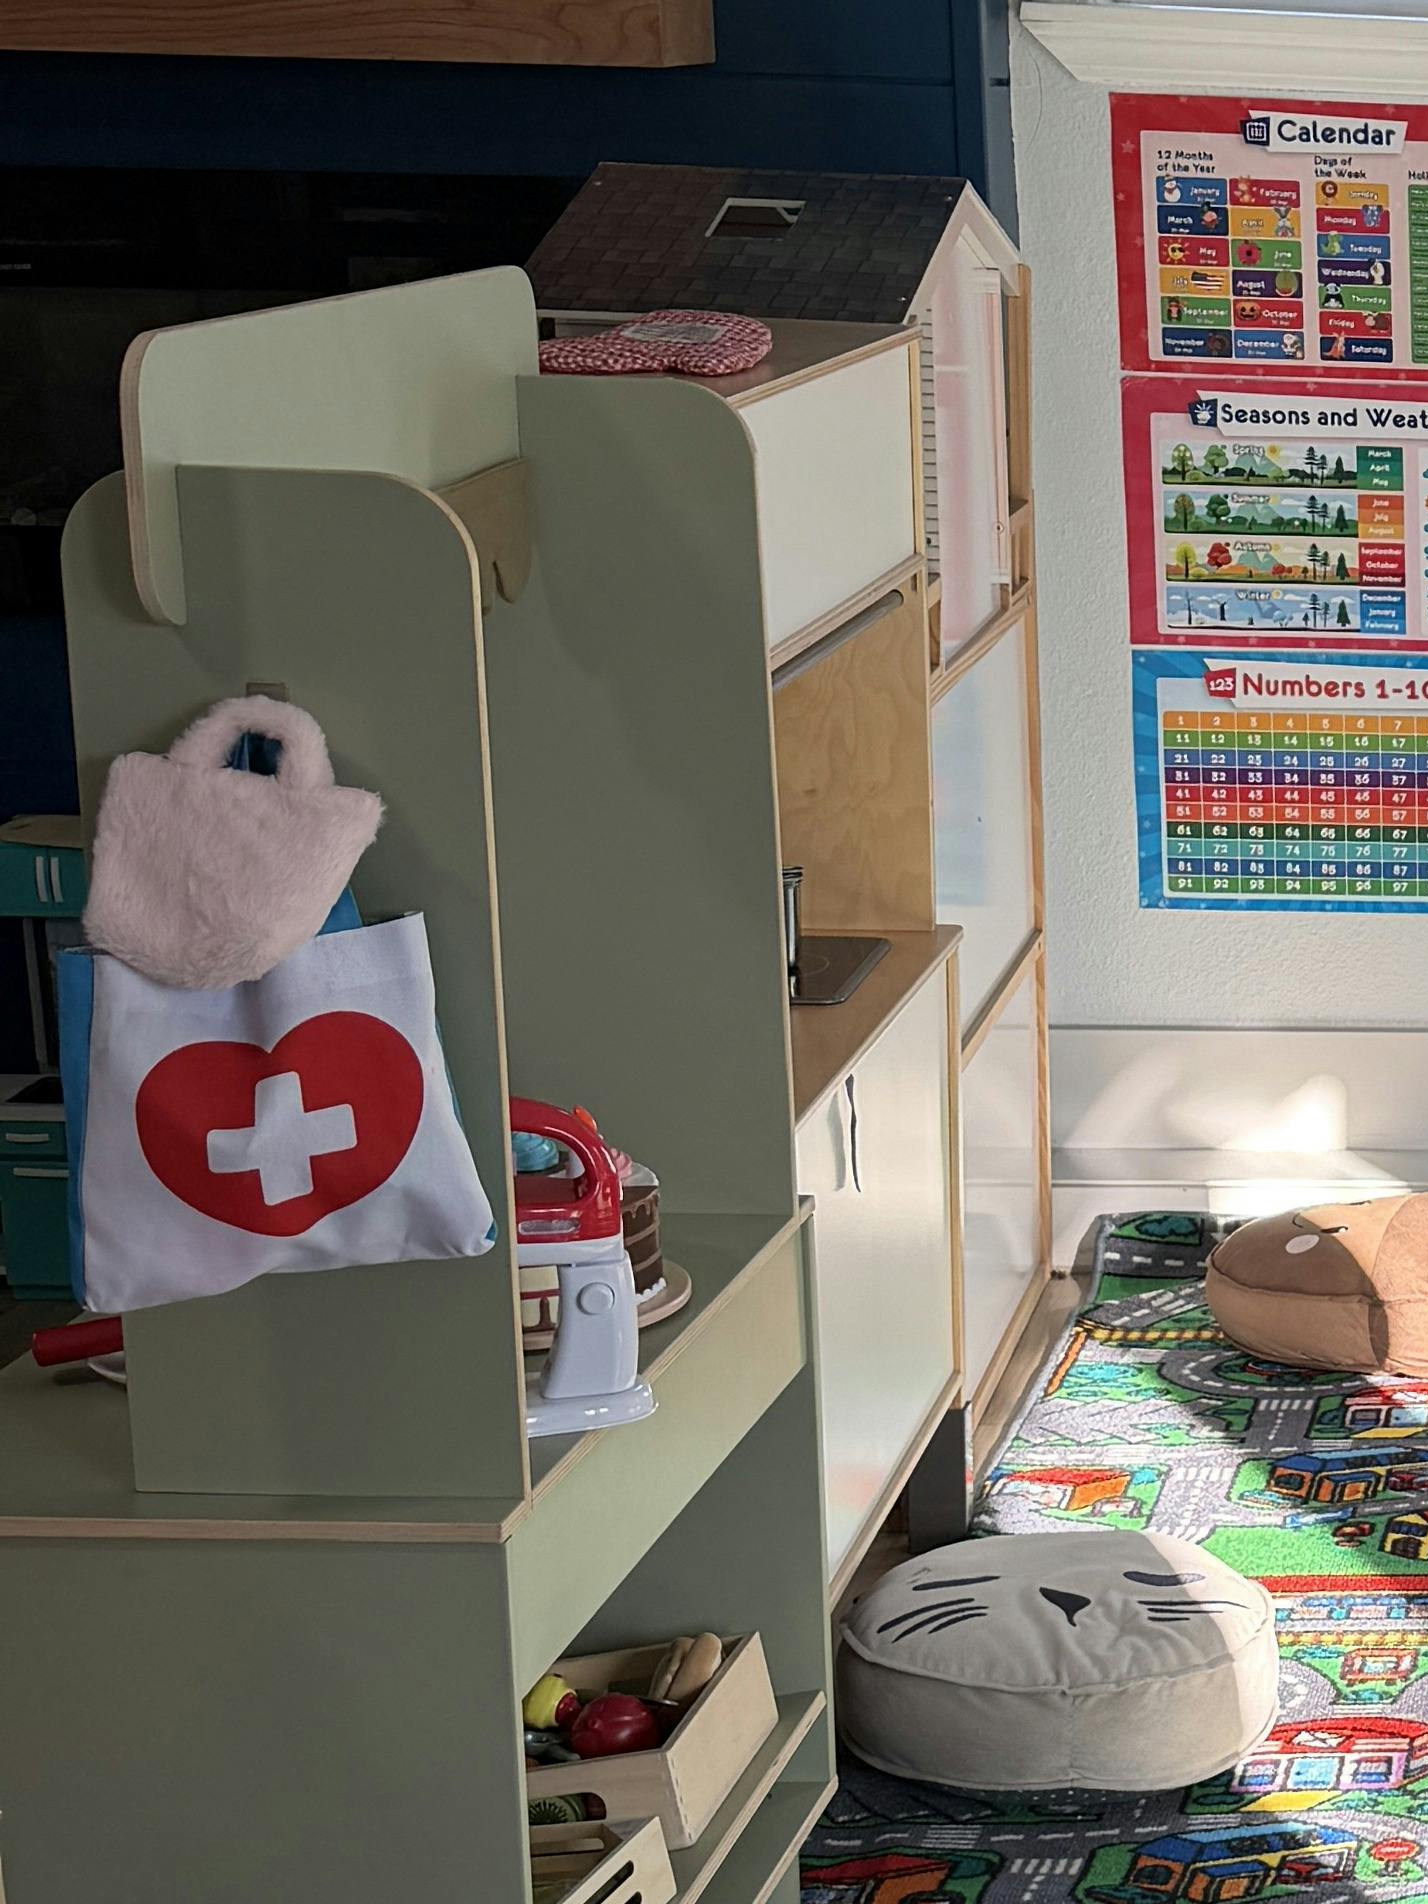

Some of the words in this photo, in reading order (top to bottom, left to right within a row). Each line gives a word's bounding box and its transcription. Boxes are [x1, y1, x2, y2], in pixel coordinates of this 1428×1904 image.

[1277, 119, 1396, 147] Calendar
[1157, 150, 1171, 159] 12
[1175, 150, 1214, 161] Months
[1314, 156, 1338, 167] Days
[1341, 156, 1353, 166] of
[1157, 162, 1168, 171] of
[1172, 162, 1189, 172] the
[1193, 163, 1215, 173] Year
[1314, 169, 1332, 178] the
[1337, 169, 1367, 179] Week
[1221, 404, 1310, 426] Seasons
[1317, 406, 1358, 427] and
[1232, 443, 1265, 457] Spring
[1235, 590, 1271, 601] Winter
[1209, 675, 1235, 694] 123
[1242, 673, 1365, 699] Numbers
